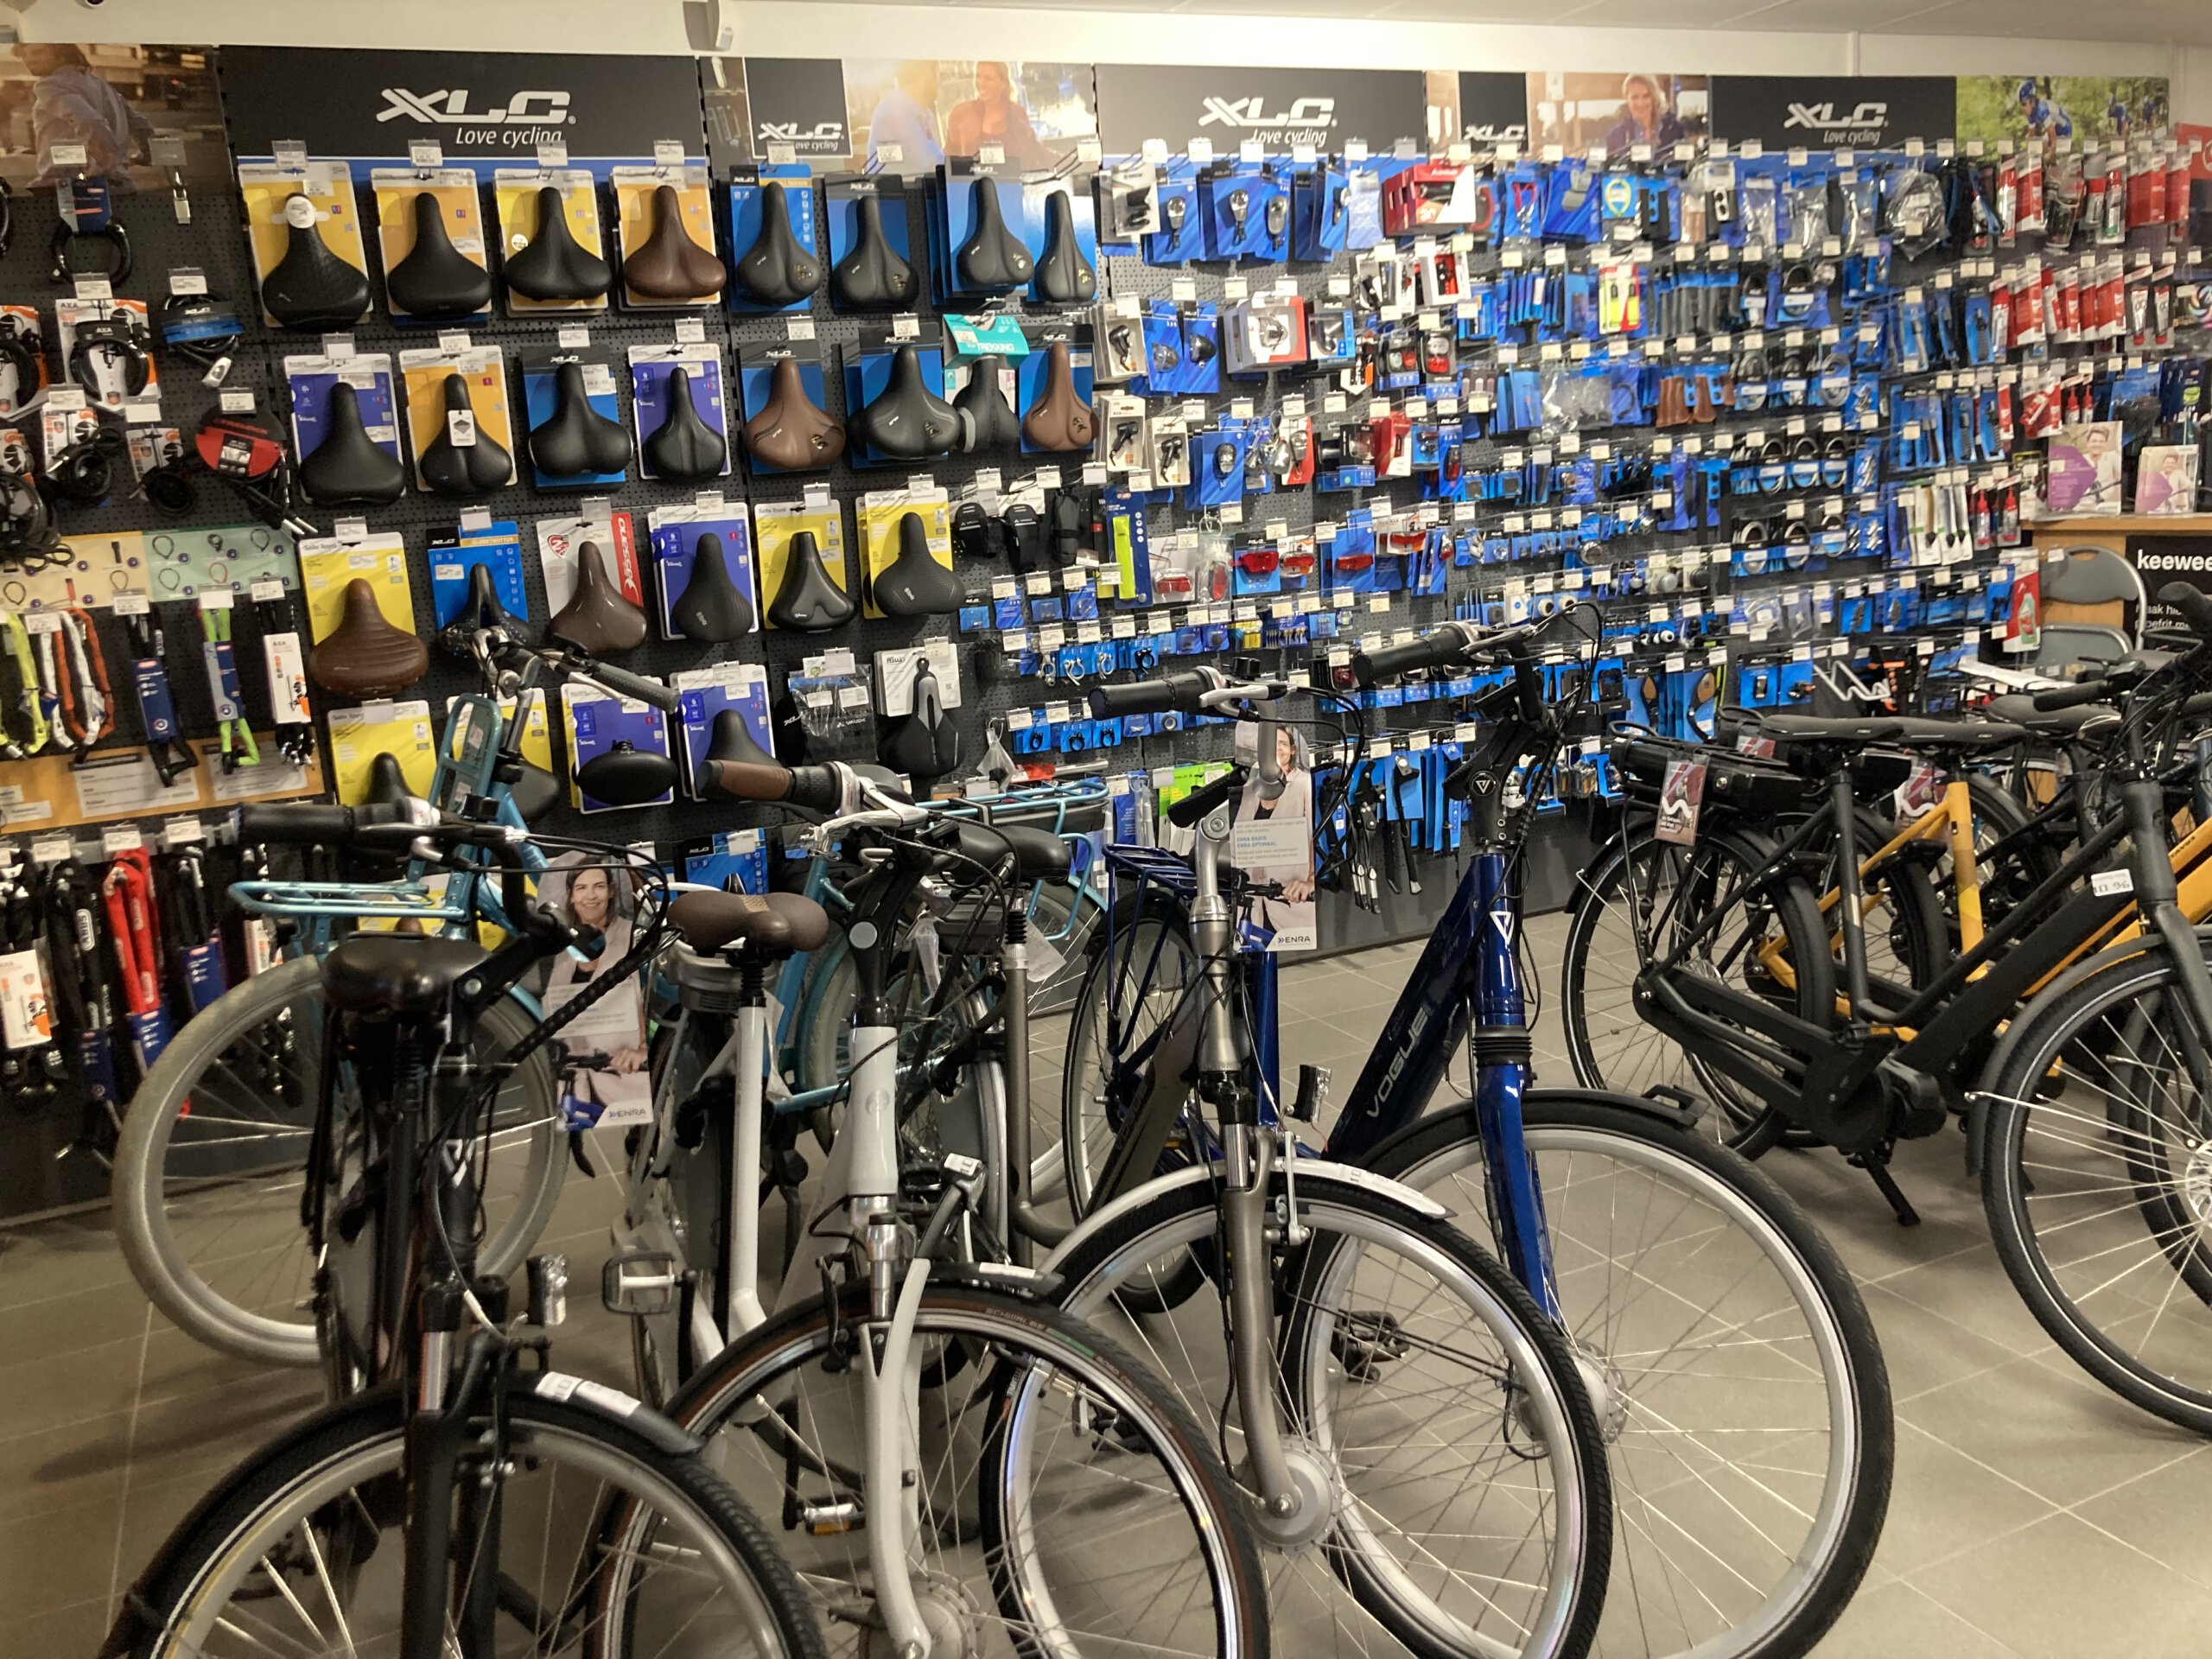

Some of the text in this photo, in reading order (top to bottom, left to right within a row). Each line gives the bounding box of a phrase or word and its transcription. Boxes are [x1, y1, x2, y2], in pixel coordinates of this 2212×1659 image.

[376, 88, 570, 124] XLC
[1198, 97, 1335, 127] XLC
[1783, 102, 1887, 129] XLC
[455, 127, 497, 145] Love
[758, 123, 843, 141] XLC
[1252, 126, 1327, 149] Love cycling
[1464, 124, 1527, 142] XLC
[1823, 130, 1882, 146] Love cycling
[795, 140, 839, 152] ove cycling
[766, 349, 792, 358] XLC
[2113, 880, 2130, 891] %
[1366, 1007, 1428, 1117] VOGUE
[617, 1109, 646, 1117] ENRA
